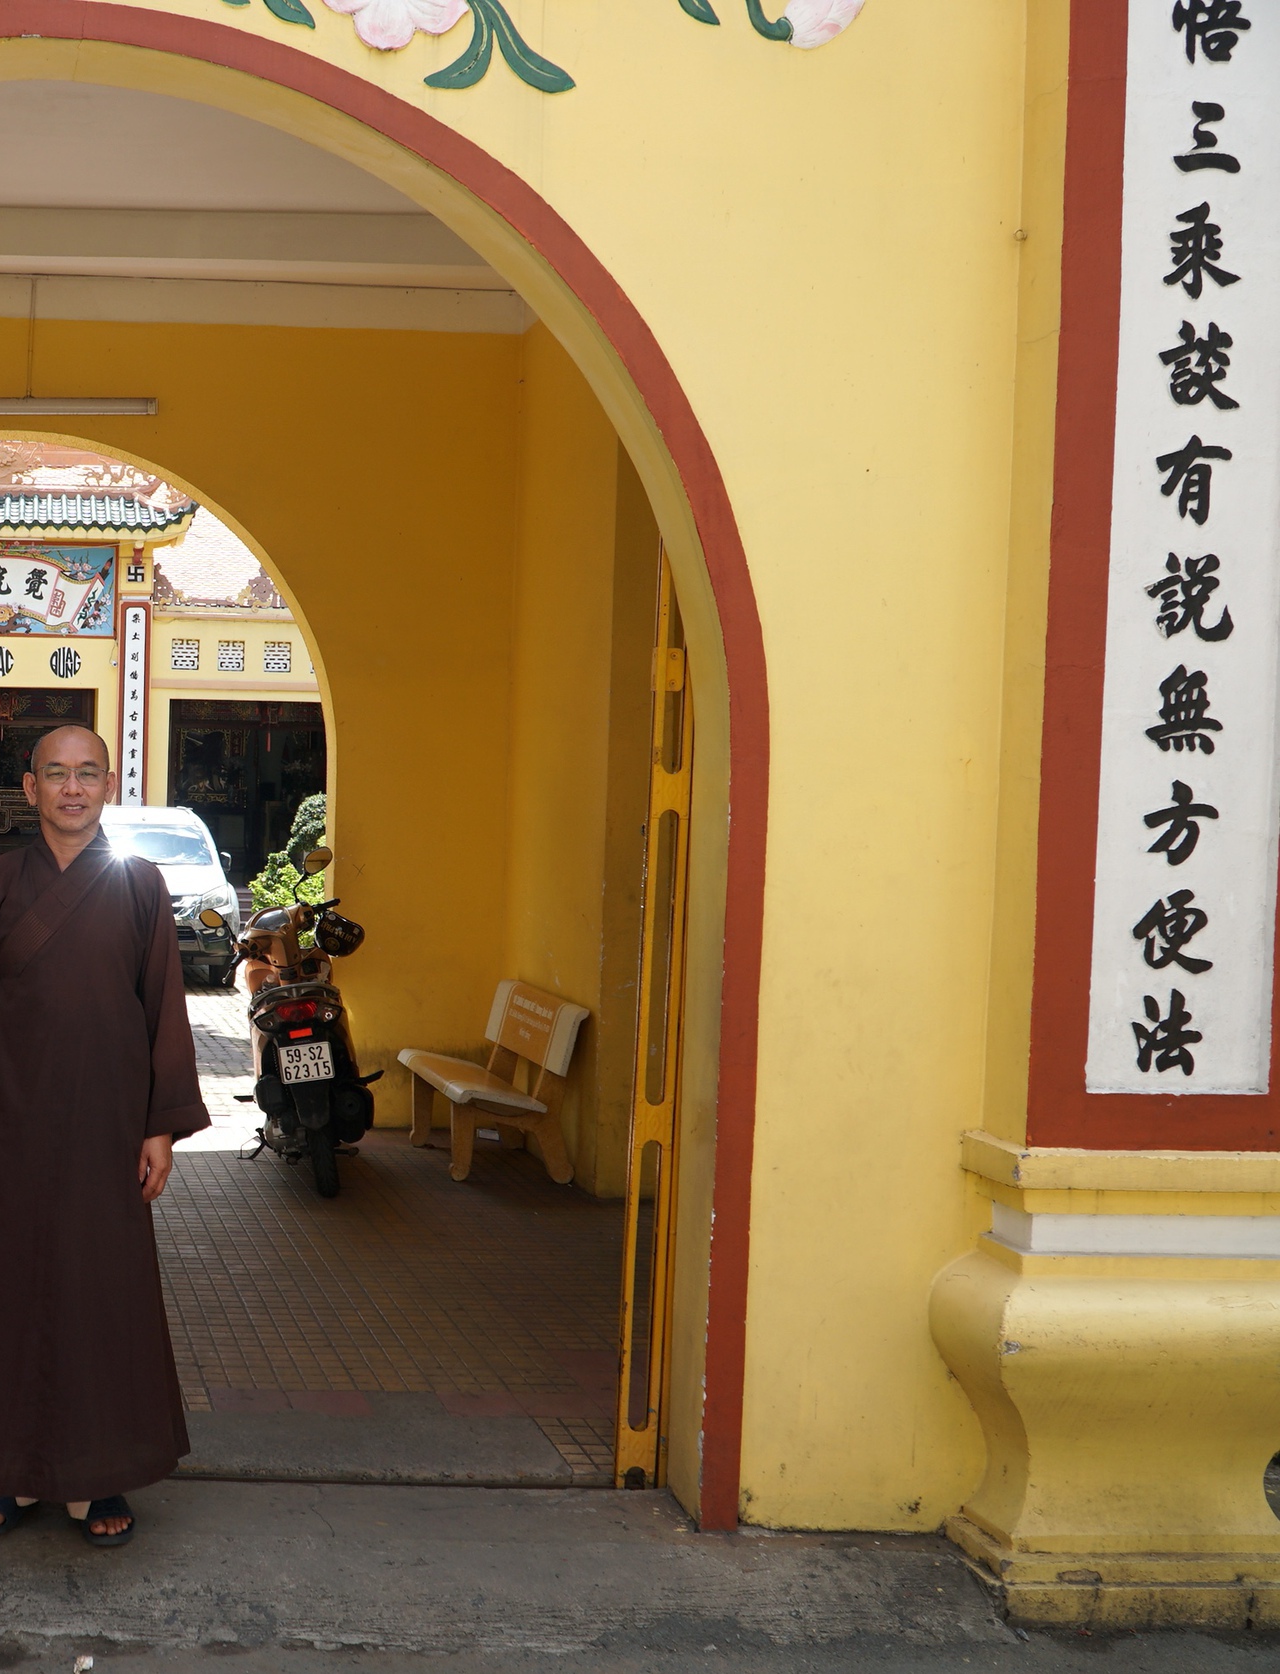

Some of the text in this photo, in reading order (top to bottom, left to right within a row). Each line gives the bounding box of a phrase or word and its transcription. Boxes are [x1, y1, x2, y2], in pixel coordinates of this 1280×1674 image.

[49, 647, 82, 679] QUANG
[286, 1045, 324, 1064] 59-S2
[284, 1061, 330, 1080] 623.15
